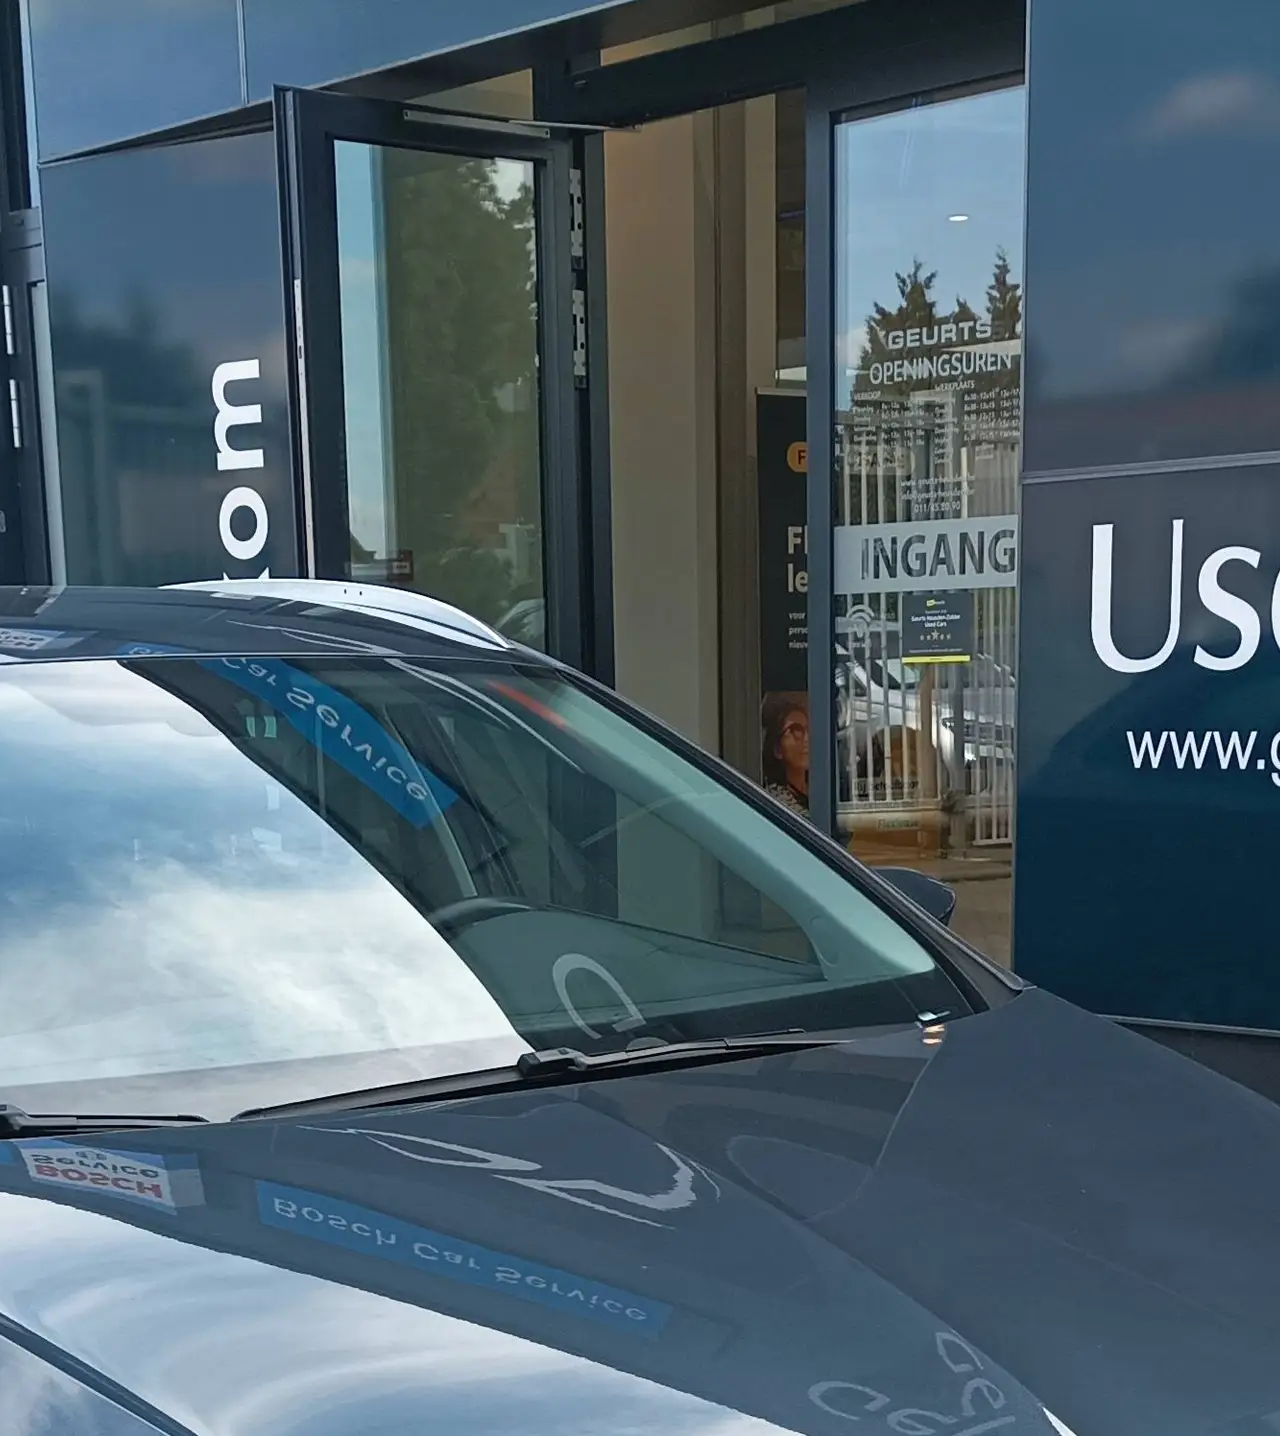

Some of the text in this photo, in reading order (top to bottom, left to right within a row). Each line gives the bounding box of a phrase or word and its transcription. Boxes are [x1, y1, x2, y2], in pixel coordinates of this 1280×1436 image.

[887, 320, 992, 350] GEURTS
[869, 352, 1012, 385] OPENINGSUREN
[211, 358, 269, 579] om
[860, 529, 1016, 580] INGANG
